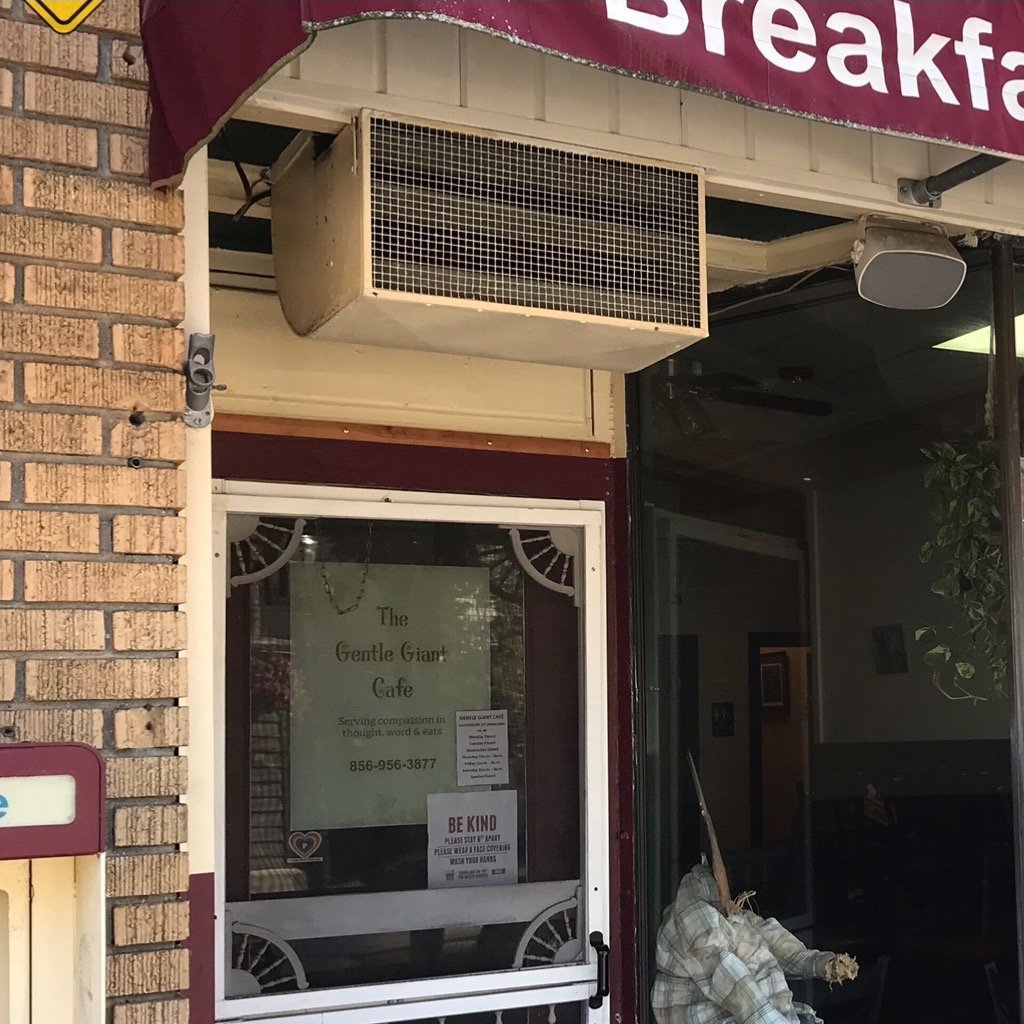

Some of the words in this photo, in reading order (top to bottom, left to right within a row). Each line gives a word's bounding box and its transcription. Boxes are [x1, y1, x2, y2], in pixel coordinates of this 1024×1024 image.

[376, 606, 409, 627] The
[335, 640, 394, 663] Gentle
[400, 641, 448, 663] Giant
[372, 676, 414, 698] Cafe
[338, 716, 376, 728] Serving
[377, 715, 434, 728] compassion
[436, 715, 446, 724] in
[386, 727, 412, 736] word
[413, 727, 420, 736] &
[422, 727, 442, 736] eats
[349, 758, 437, 772] 856-956-3877
[448, 816, 463, 833] BE
[467, 814, 497, 833] KIND
[444, 837, 463, 845] PLEASE
[464, 836, 476, 844] STAY
[485, 834, 501, 842] APART
[434, 847, 453, 856] PLEASE
[454, 846, 468, 854] WEAR
[469, 846, 473, 854] A
[473, 845, 486, 853] FACE
[486, 844, 511, 852] COVERING
[450, 857, 465, 865] WASH
[466, 856, 479, 864] YOUR
[479, 855, 497, 864] HANDS
